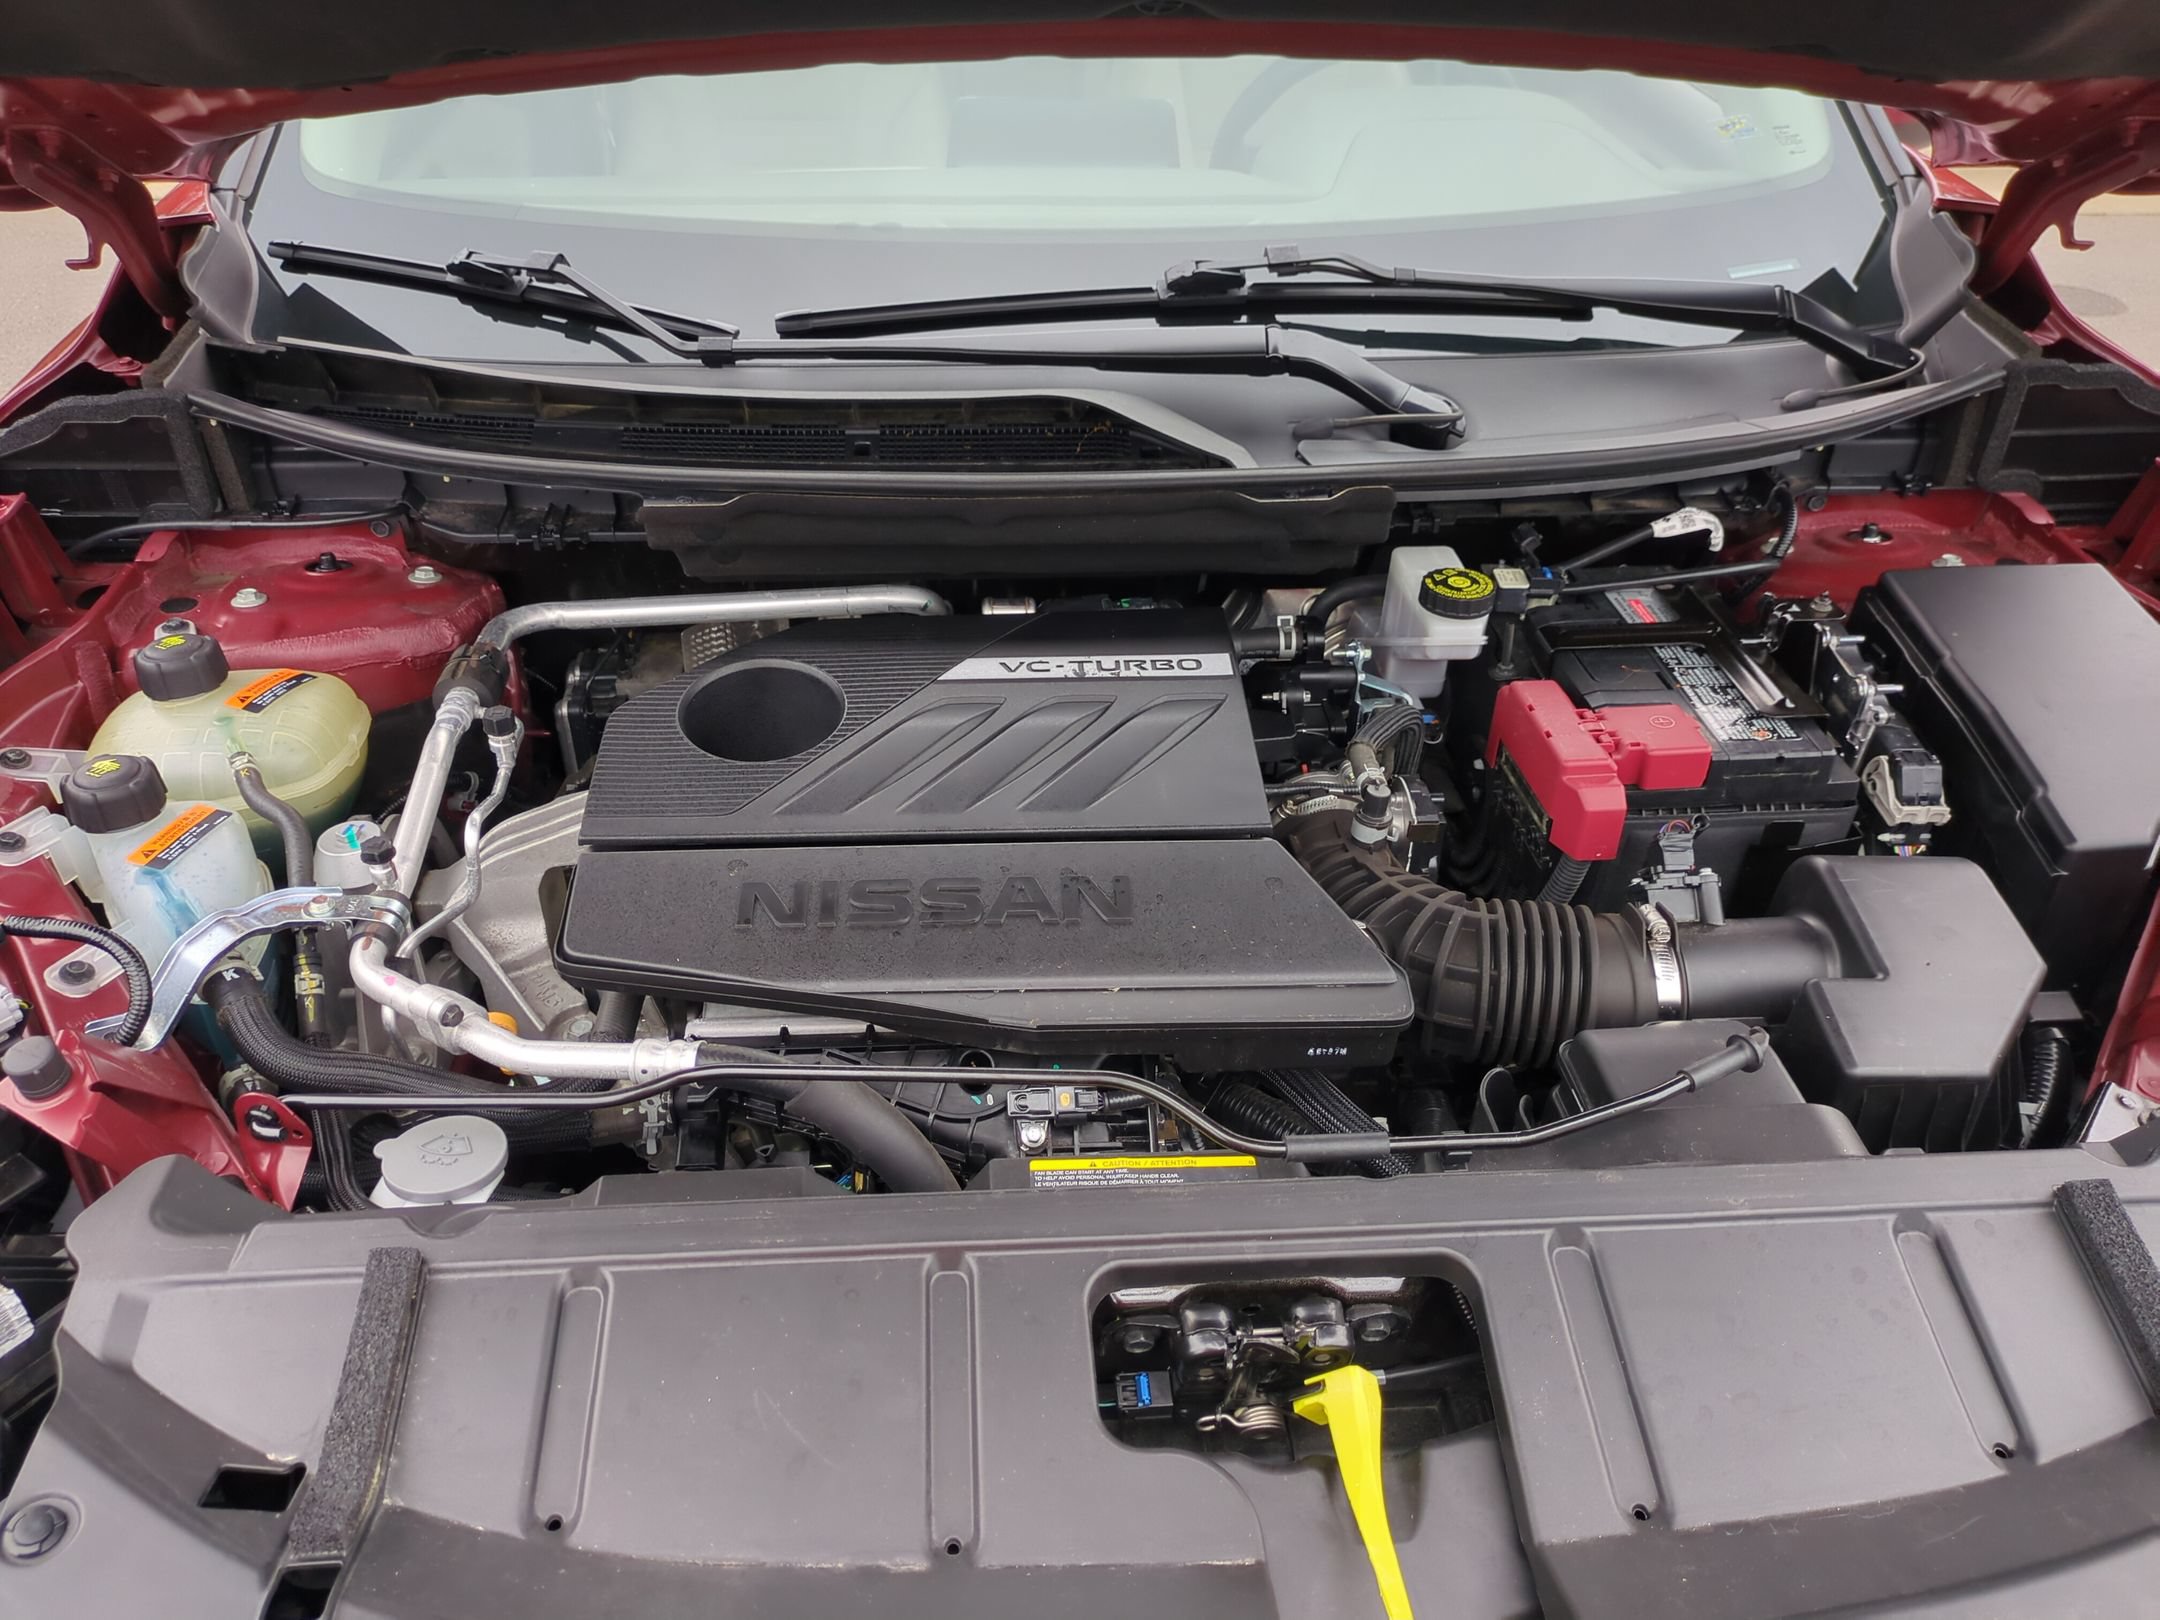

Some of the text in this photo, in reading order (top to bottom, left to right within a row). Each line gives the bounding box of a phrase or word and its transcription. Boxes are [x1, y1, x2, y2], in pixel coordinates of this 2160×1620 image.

[999, 658, 1204, 674] VC-TURBO
[734, 875, 1134, 929] NISSAN
[222, 968, 240, 982] K
[1150, 1158, 1197, 1166] ATTENTION
